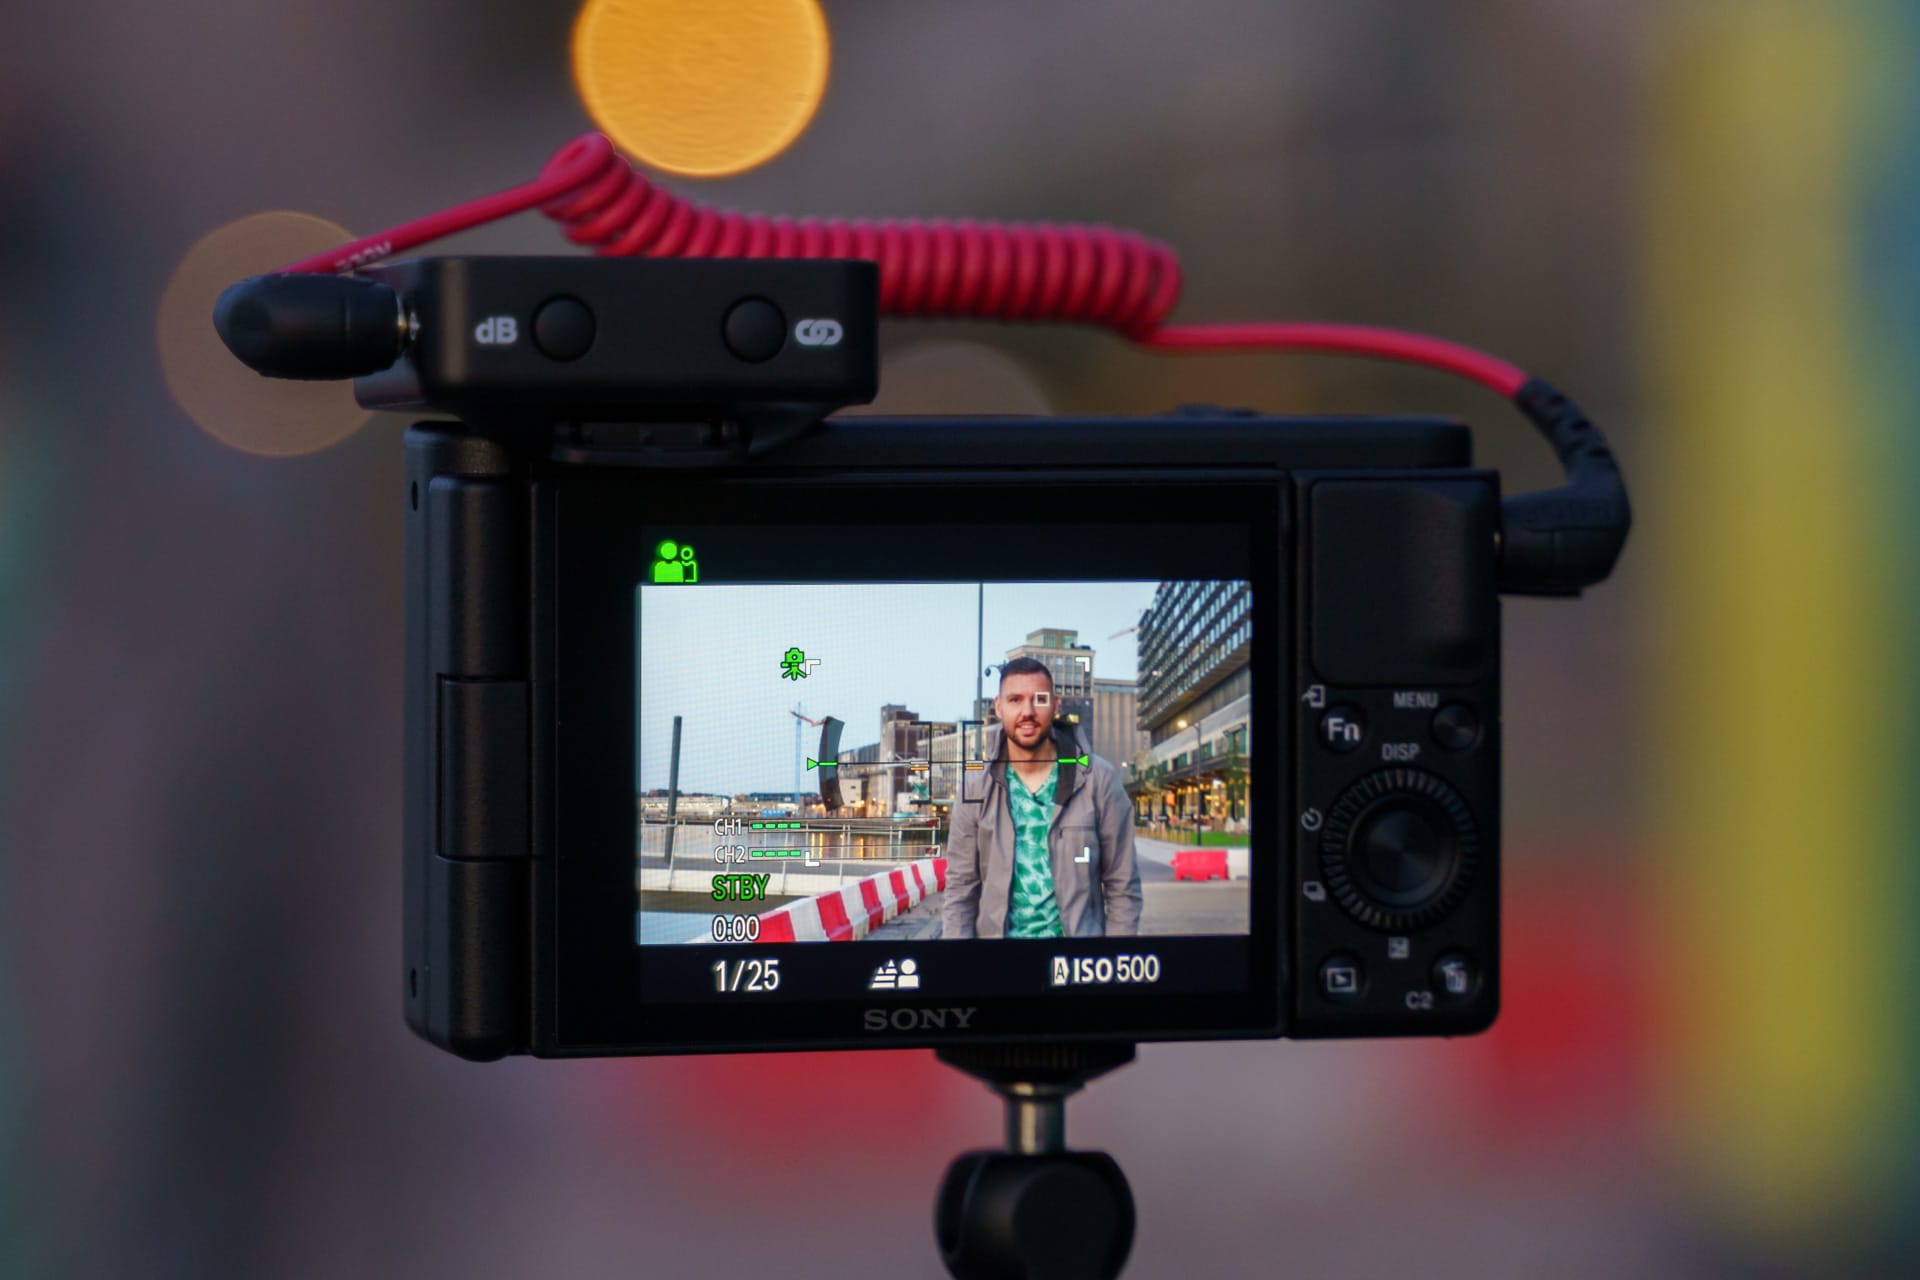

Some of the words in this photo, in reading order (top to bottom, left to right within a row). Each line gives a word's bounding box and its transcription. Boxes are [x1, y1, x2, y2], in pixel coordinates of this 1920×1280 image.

[475, 316, 518, 344] dB
[1393, 691, 1439, 709] MENU
[1327, 717, 1361, 742] Fn
[1381, 743, 1420, 761] DISP
[713, 818, 743, 836] CH1
[713, 846, 746, 864] CH2
[711, 873, 771, 901] STBY
[712, 915, 760, 941] 0:00
[713, 959, 780, 992] 1/25
[1405, 990, 1434, 1010] C2
[863, 1007, 977, 1031] SONY
